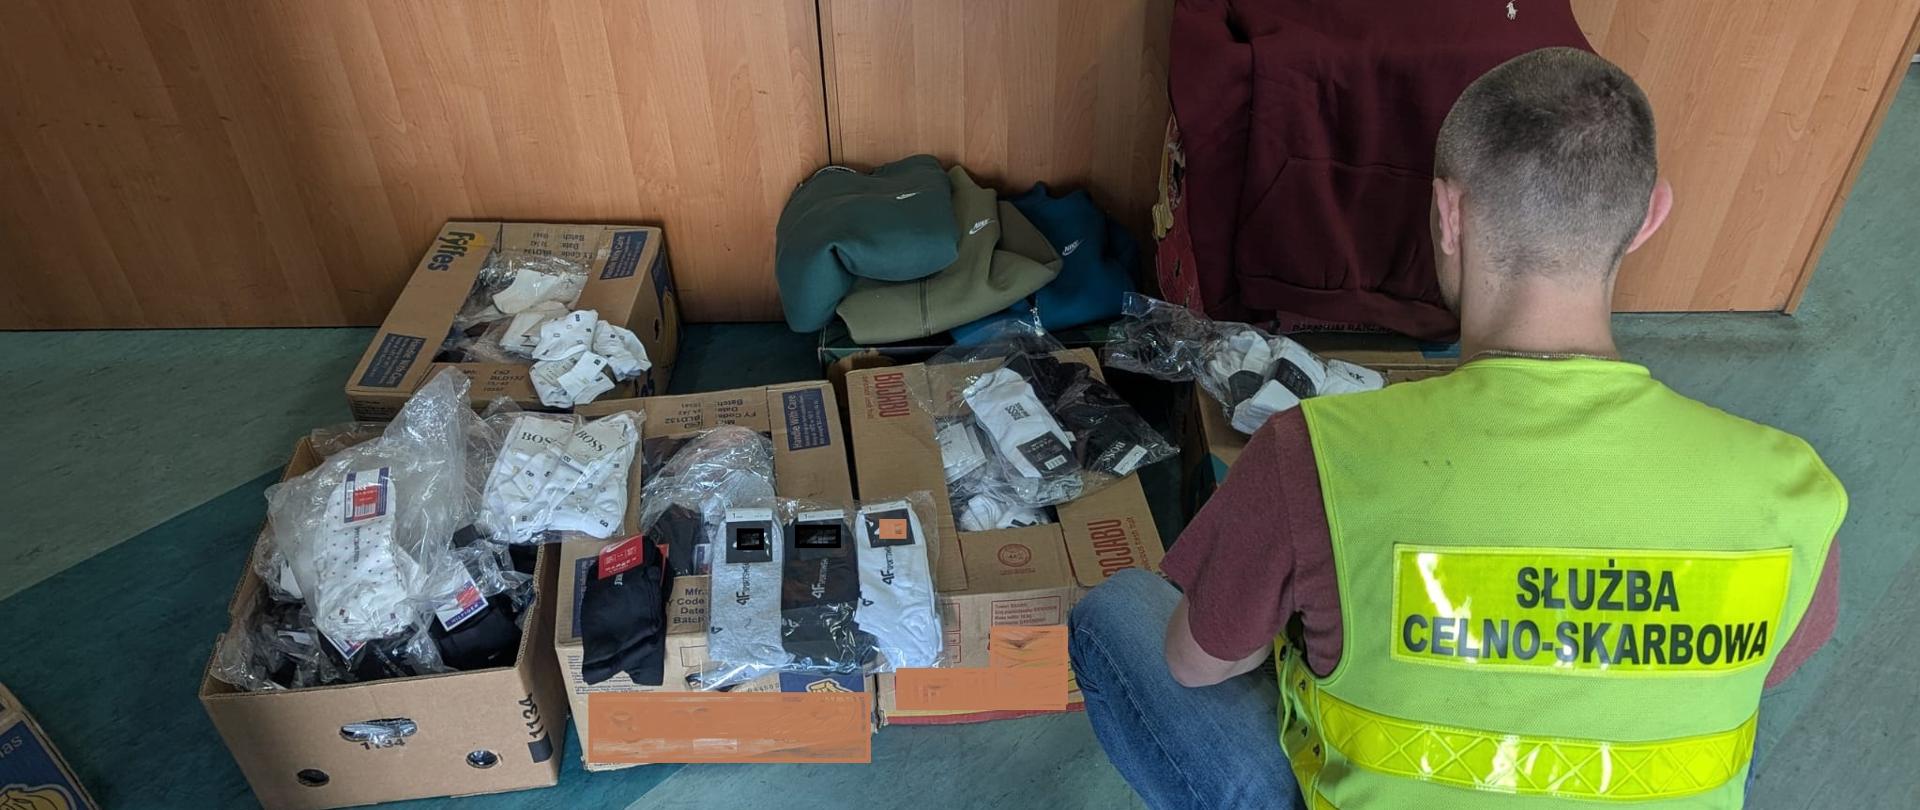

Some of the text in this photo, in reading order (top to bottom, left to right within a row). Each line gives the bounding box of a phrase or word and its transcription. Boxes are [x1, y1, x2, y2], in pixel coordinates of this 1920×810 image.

[428, 231, 475, 271] Fyffes
[874, 372, 910, 417] BOJABU
[576, 430, 606, 451] BOSS
[811, 583, 825, 599] 4F
[880, 569, 895, 585] 4F
[1516, 559, 1680, 612] SŁUŻBA
[677, 597, 705, 605] Code
[1403, 614, 1768, 665] CELNO-SKARBOWA
[519, 693, 544, 738] 1134
